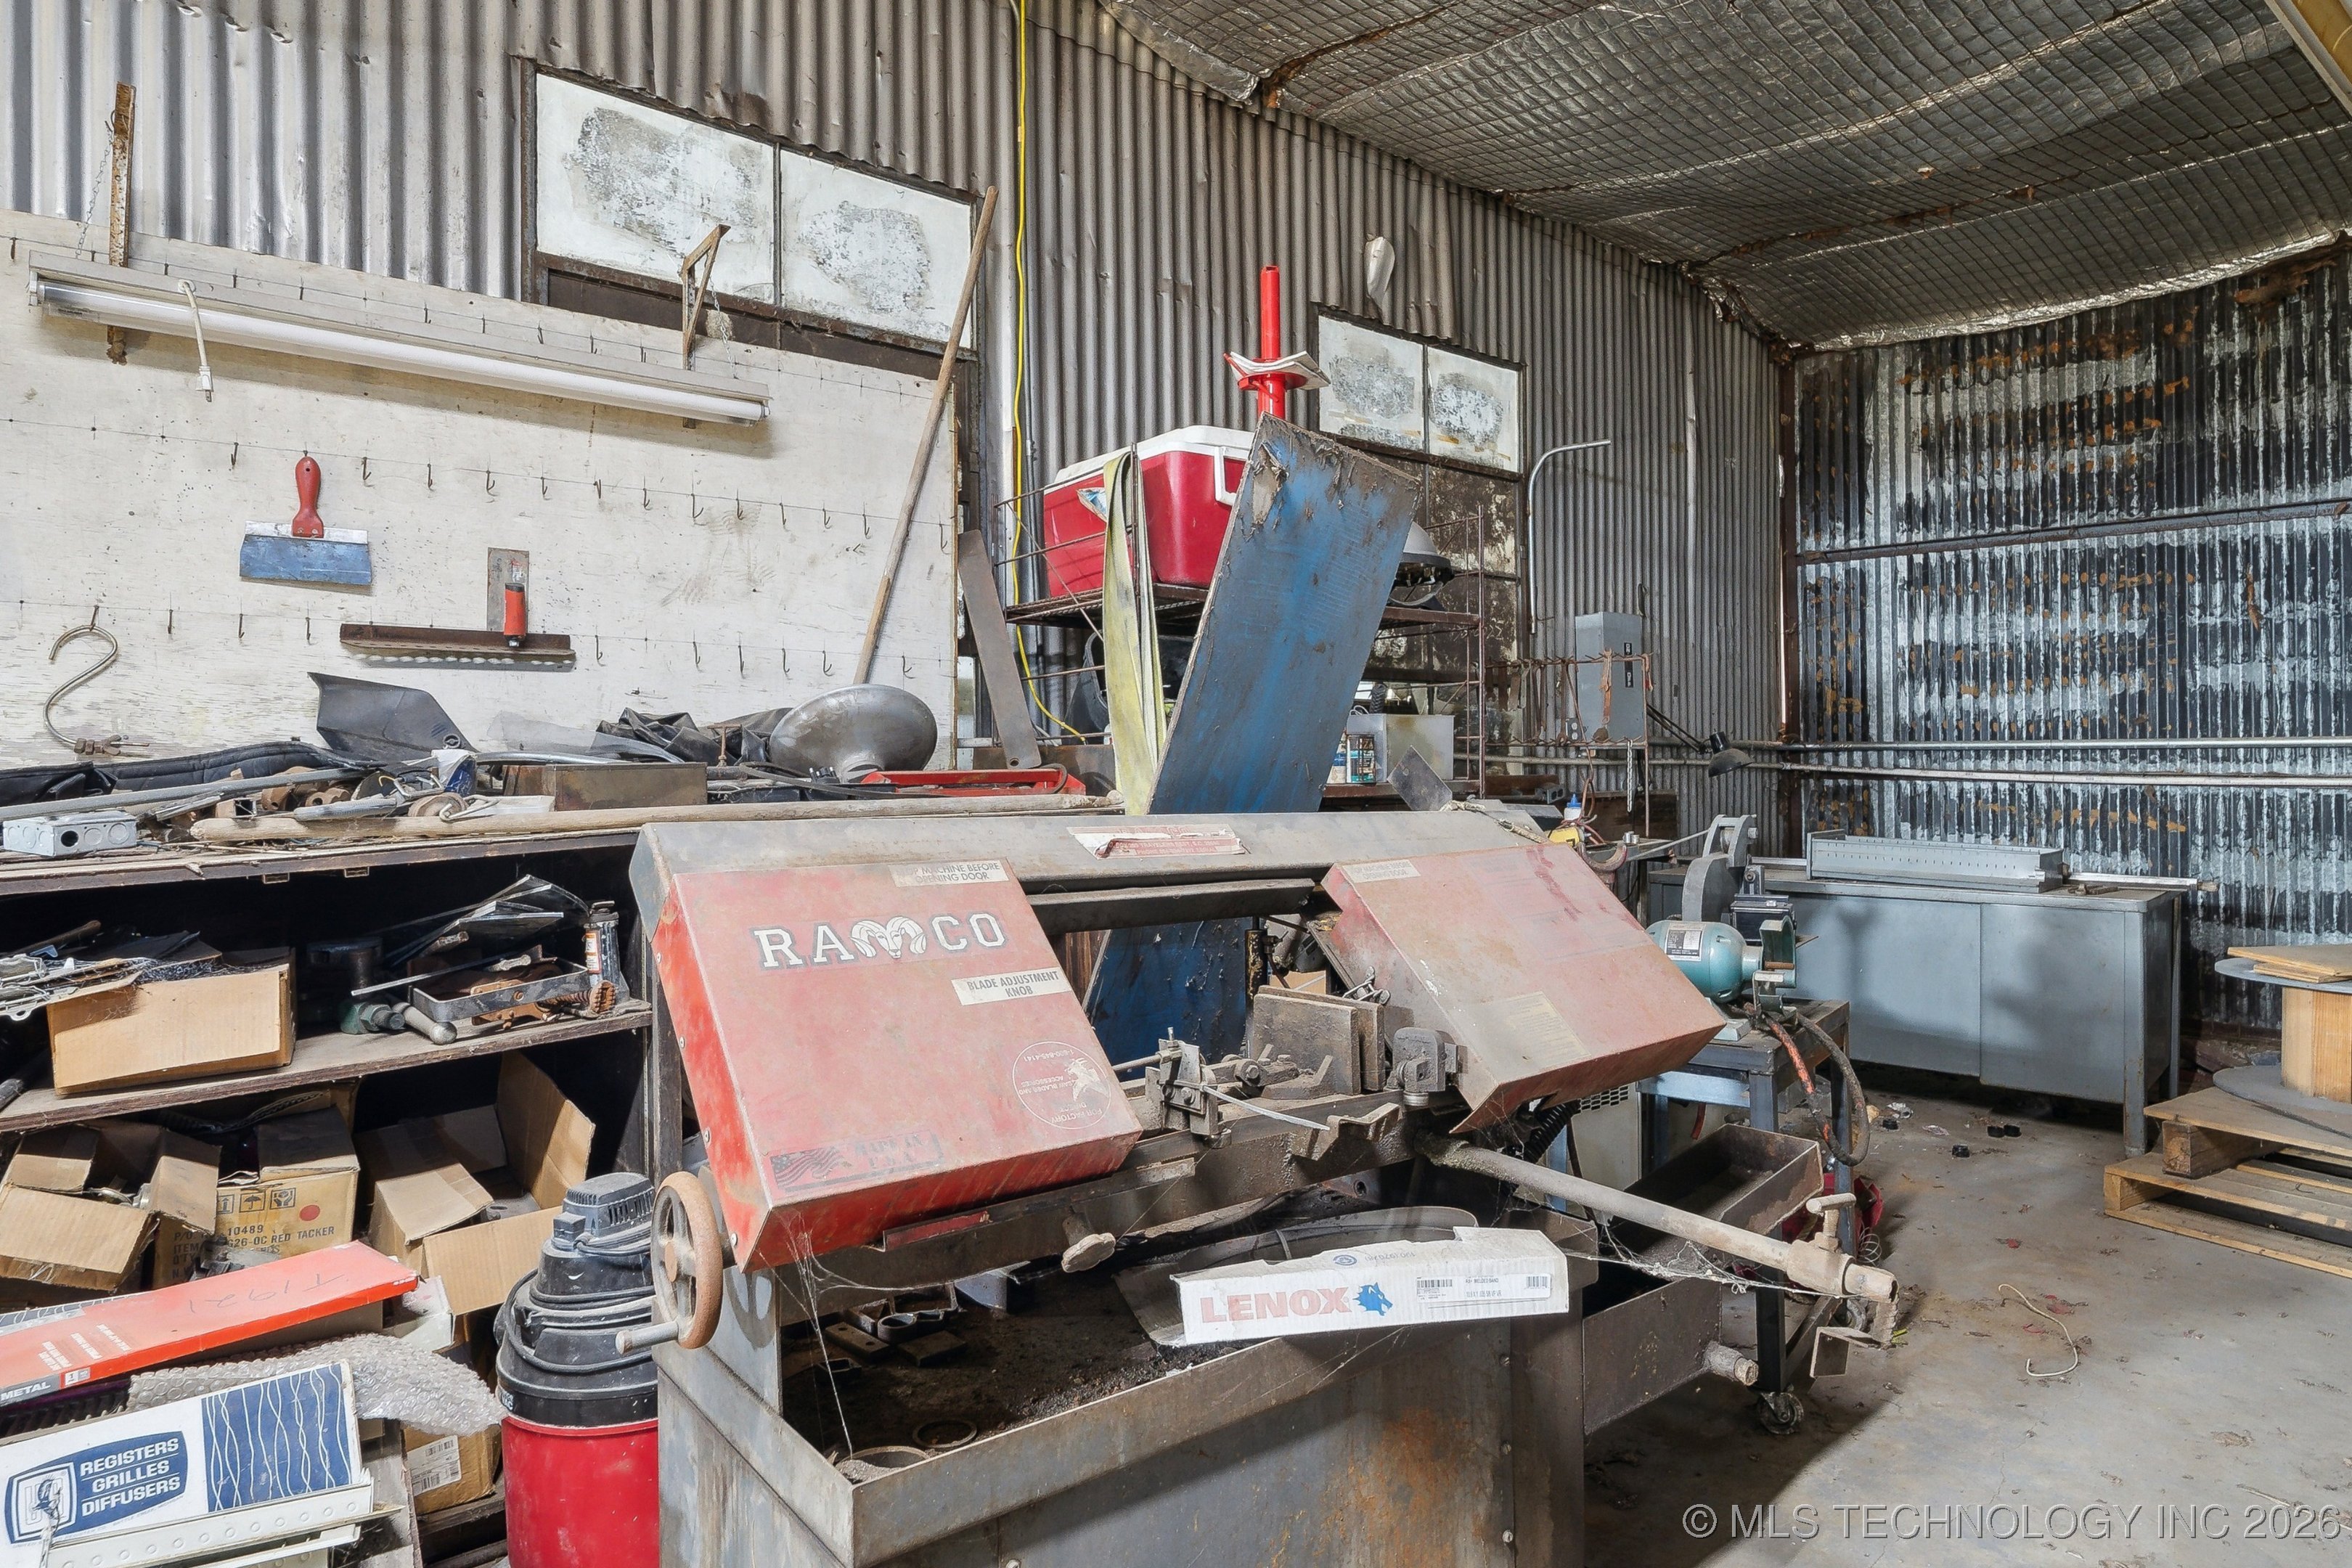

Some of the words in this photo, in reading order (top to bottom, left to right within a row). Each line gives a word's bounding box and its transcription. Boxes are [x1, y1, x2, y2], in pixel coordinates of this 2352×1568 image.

[915, 873, 959, 883] OPENING
[962, 871, 989, 881] DOOR
[967, 862, 1000, 873] BEFORE
[967, 979, 998, 991] BLADE
[1000, 971, 1060, 986] ADJUSTMENT
[1005, 985, 1034, 997] KNOB
[1034, 1083, 1058, 1093] BLADES
[1051, 1111, 1086, 1124] FACTORY
[174, 1242, 200, 1254] ITEM
[271, 1233, 291, 1244] RED
[297, 1225, 335, 1240] TACKER
[227, 1224, 264, 1236] 10489
[1200, 1286, 1352, 1323] LENOX
[0, 1381, 52, 1402] METAL
[80, 1437, 179, 1477] REGISTERS
[92, 1460, 170, 1493] GRILLES
[81, 1475, 181, 1517] DIFFUSERS
